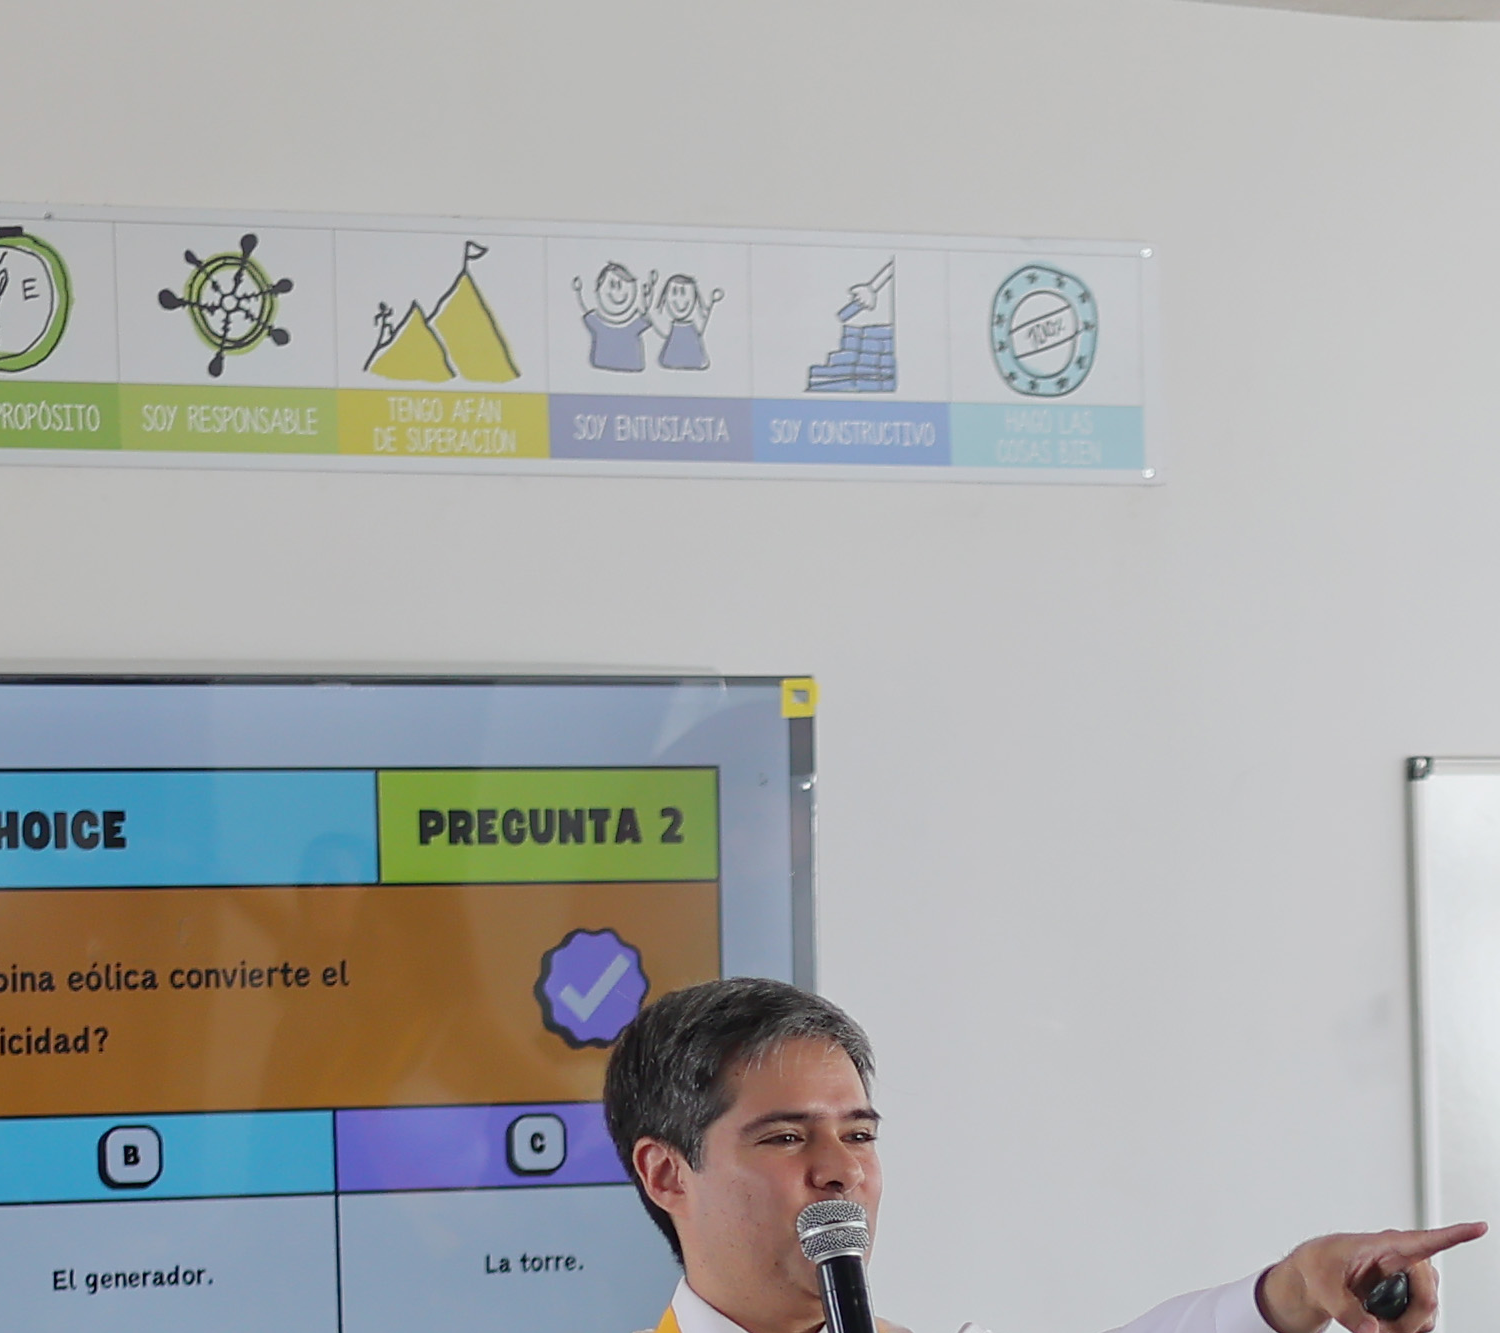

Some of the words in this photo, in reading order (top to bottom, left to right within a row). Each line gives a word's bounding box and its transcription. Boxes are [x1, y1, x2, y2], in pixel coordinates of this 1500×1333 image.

[142, 405, 180, 432] SOY
[188, 406, 319, 436] RESPONSABLE
[387, 397, 443, 422] TENGO
[372, 427, 399, 450] DE
[573, 413, 607, 441] SOY
[615, 414, 730, 443] ENTUSIASTA
[770, 419, 799, 445] SOY
[806, 419, 936, 448] CONSTRUCTIVO
[418, 806, 644, 847] PREGUNTA
[660, 806, 684, 844] 2
[67, 961, 159, 993] eólica
[169, 959, 311, 990] convierte
[322, 959, 350, 987] el
[122, 1143, 141, 1168] B
[530, 1131, 547, 1154] C
[484, 1252, 512, 1275] La
[520, 1250, 586, 1274] torre.
[52, 1269, 77, 1292] El
[84, 1264, 215, 1296] generador.
